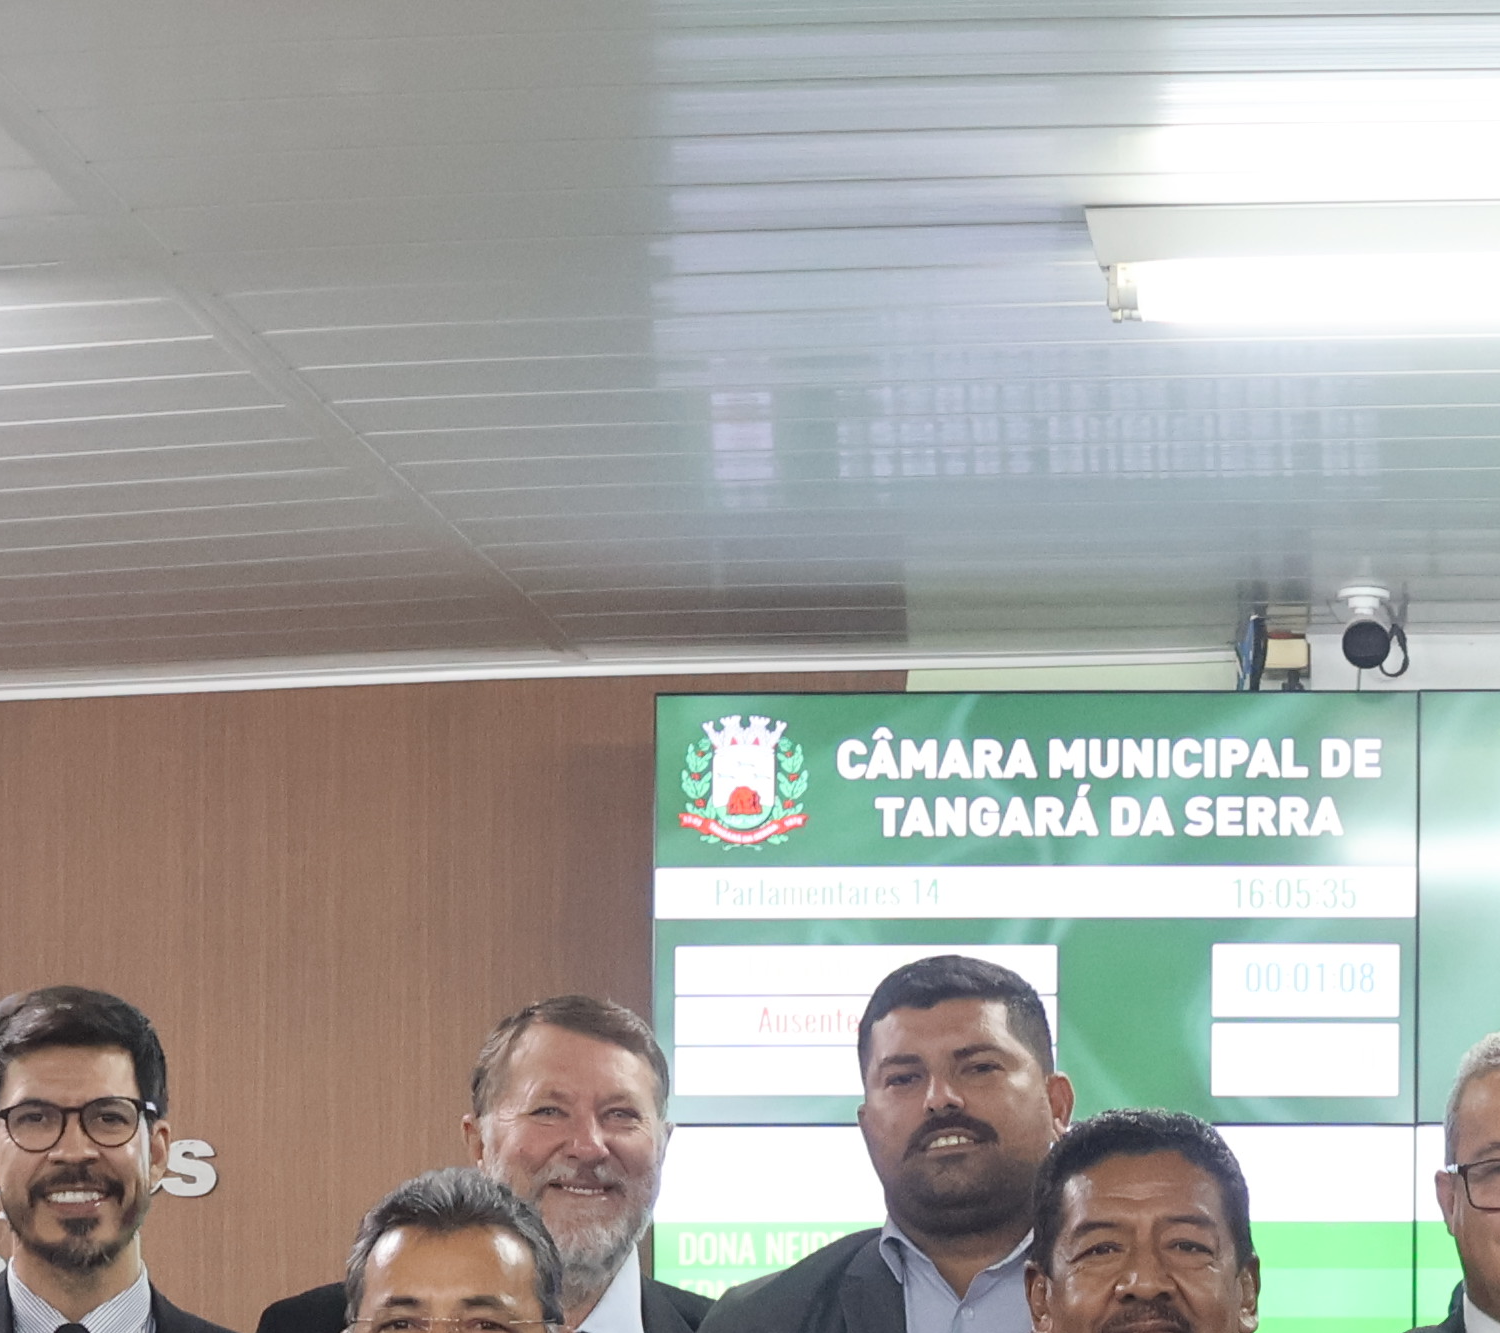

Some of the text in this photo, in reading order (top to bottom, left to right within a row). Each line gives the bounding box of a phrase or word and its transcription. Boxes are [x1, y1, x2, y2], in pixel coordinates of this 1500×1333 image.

[836, 727, 1382, 779] CÂMARA MUNICIPAL DE
[875, 785, 1344, 838] TANGARÁ DA SERRA
[714, 879, 940, 906] Parlamentares 14
[1232, 877, 1357, 909] 16:05:35
[1245, 963, 1375, 993] 00:01:08
[678, 1231, 757, 1266] DONA
